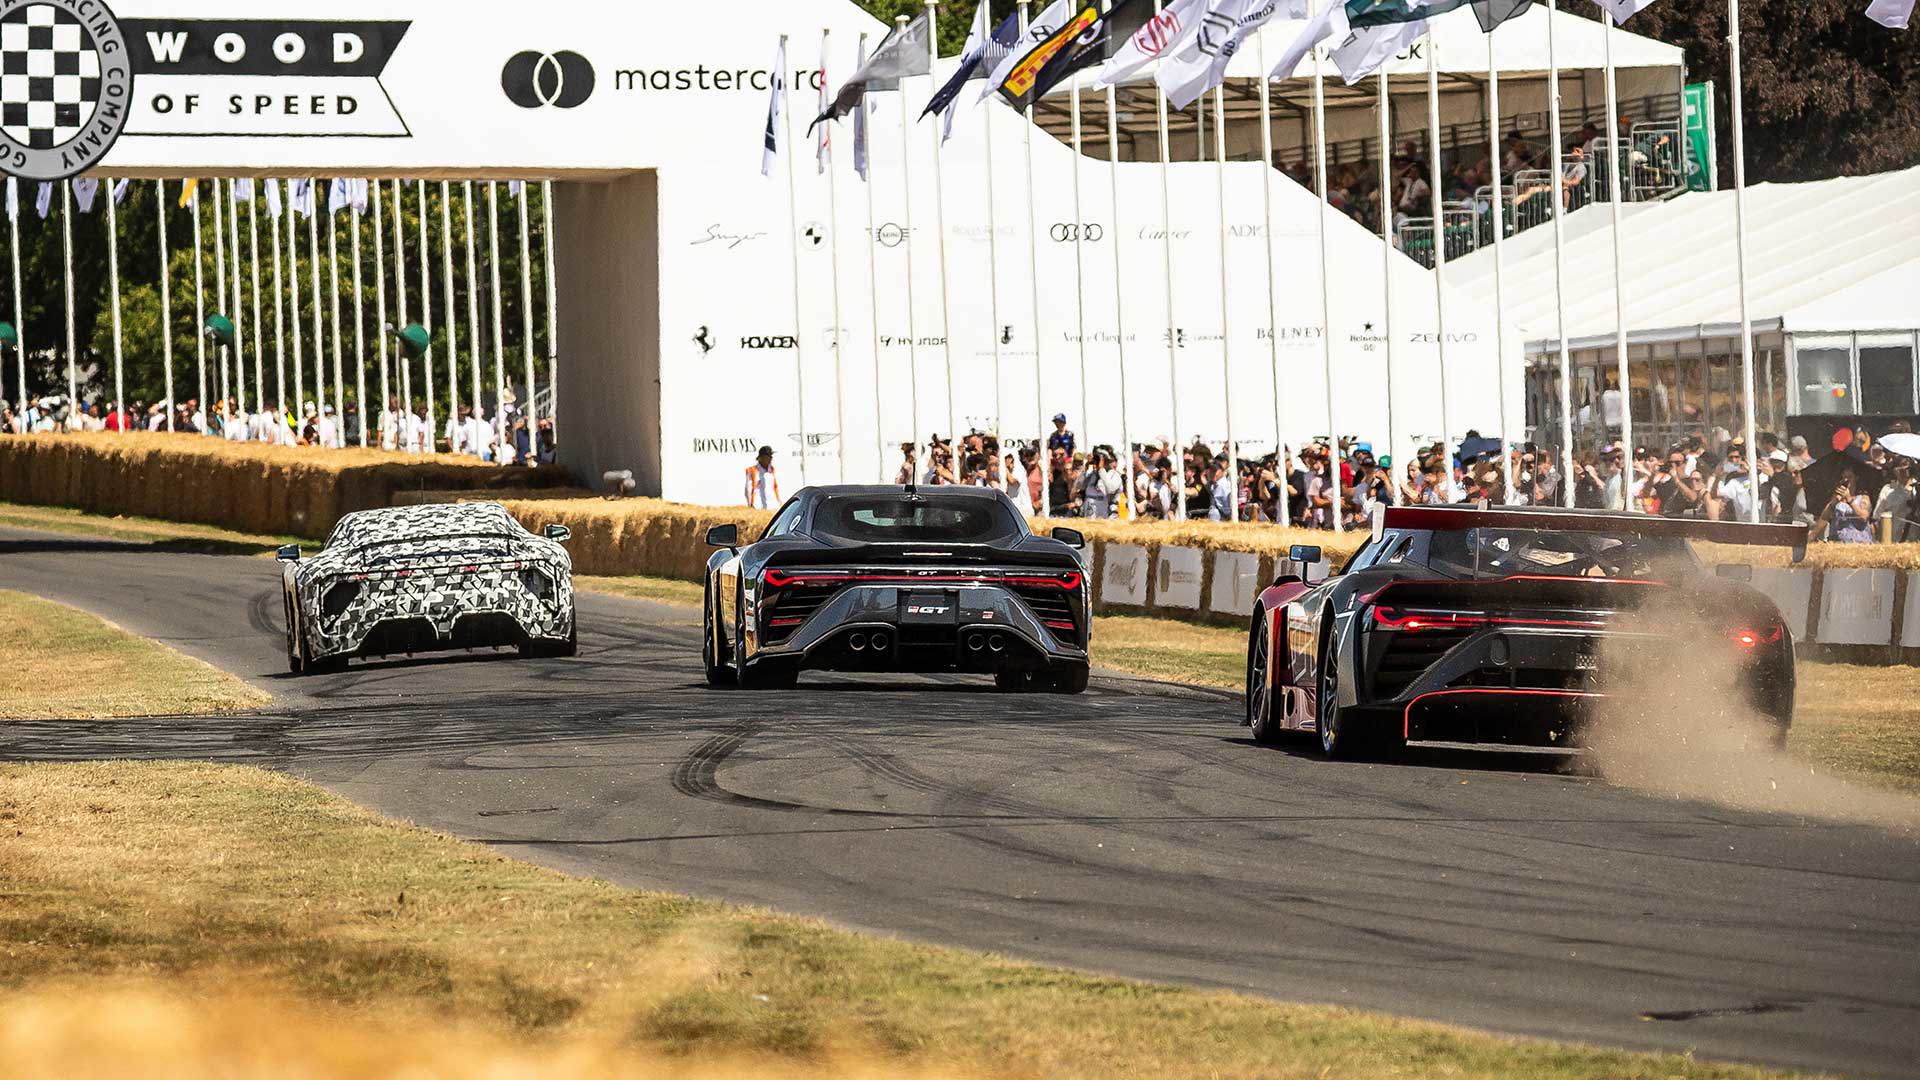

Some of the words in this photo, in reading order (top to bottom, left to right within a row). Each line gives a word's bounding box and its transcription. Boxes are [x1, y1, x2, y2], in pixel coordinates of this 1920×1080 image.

[146, 31, 365, 64] WOOD
[151, 95, 200, 115] OF
[228, 95, 358, 115] SPEED
[61, 67, 124, 170] COMPANY
[693, 437, 757, 453] BONHAMS
[919, 606, 950, 614] GT
